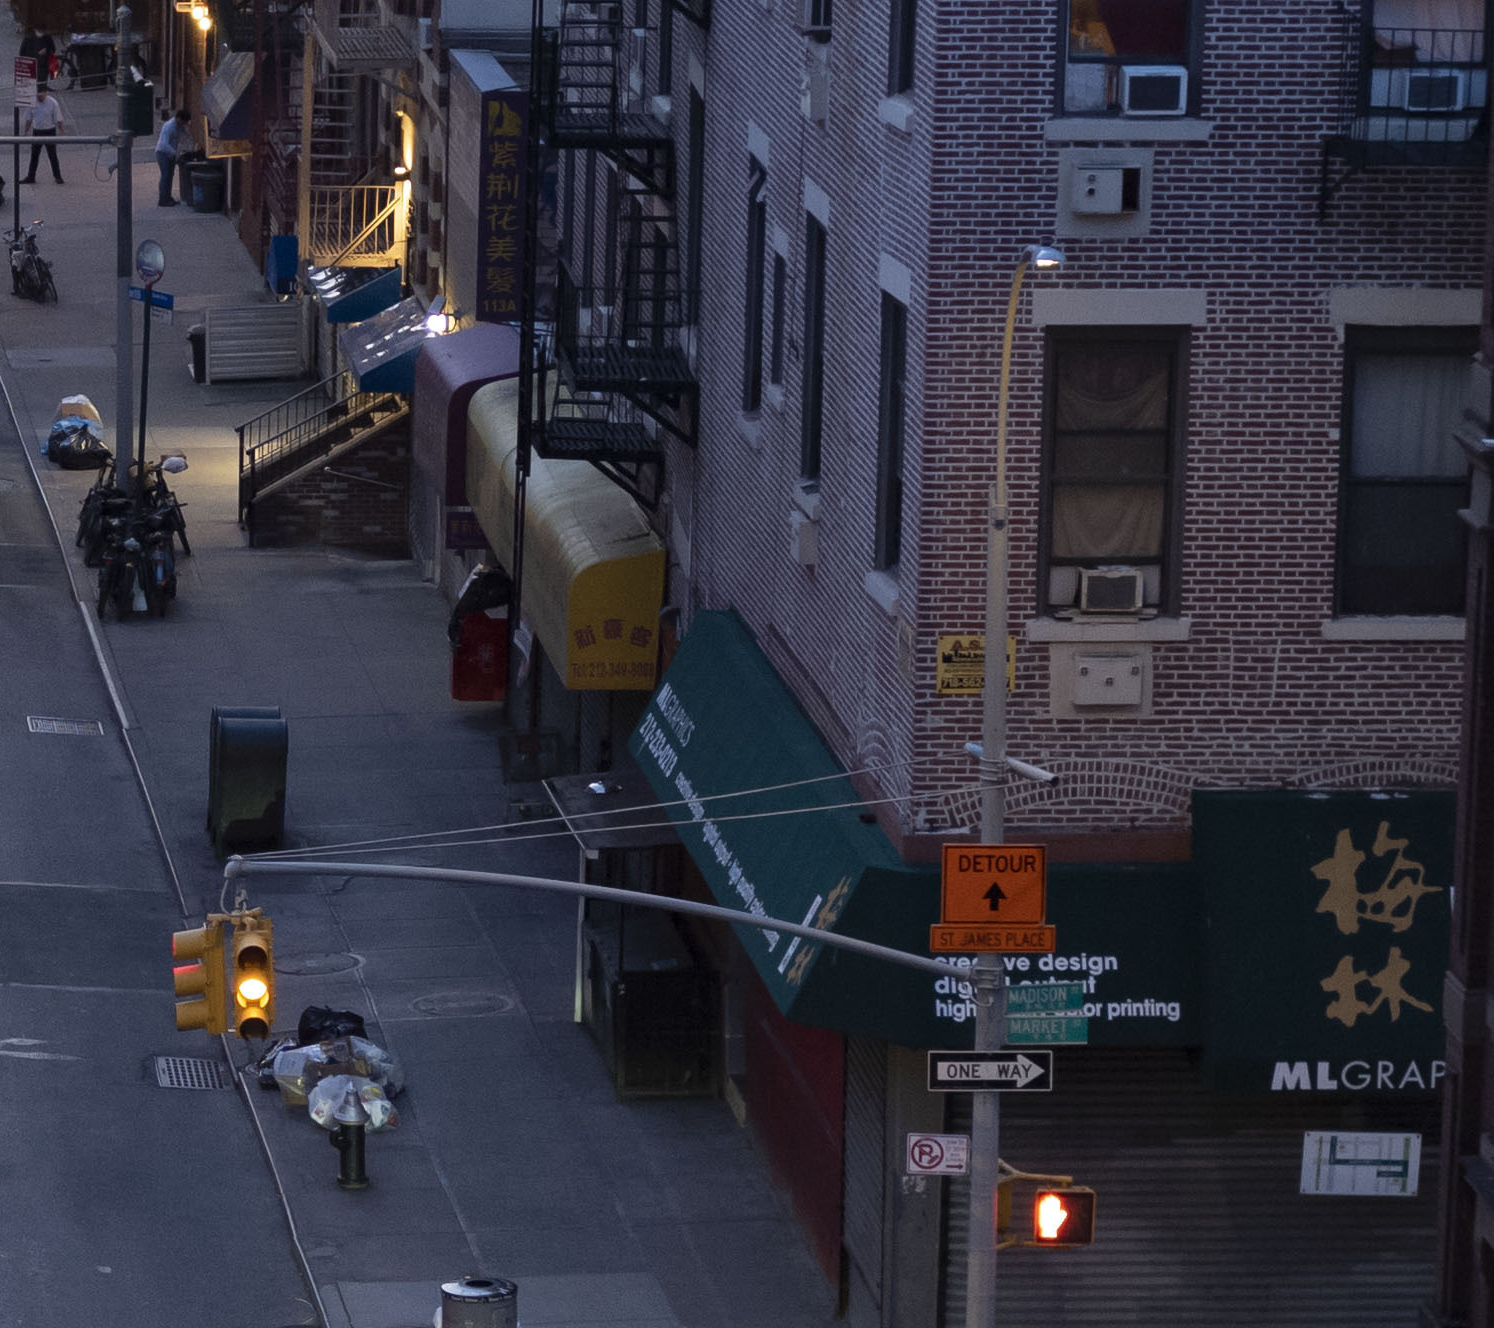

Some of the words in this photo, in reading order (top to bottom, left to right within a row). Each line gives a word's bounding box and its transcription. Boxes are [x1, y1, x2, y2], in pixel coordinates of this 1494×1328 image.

[483, 299, 517, 313] 113A
[958, 855, 1037, 872] DETOUR
[1311, 819, 1443, 1028] 梅林
[961, 933, 1002, 947] JAMES
[1005, 933, 1046, 947] PLACE
[1038, 953, 1118, 975] design
[1009, 987, 1068, 1004] MADISON
[1107, 998, 1181, 1021] printing
[1010, 1019, 1068, 1034] MARKET
[947, 1064, 981, 1078] ONE
[997, 1064, 1032, 1078] WAY
